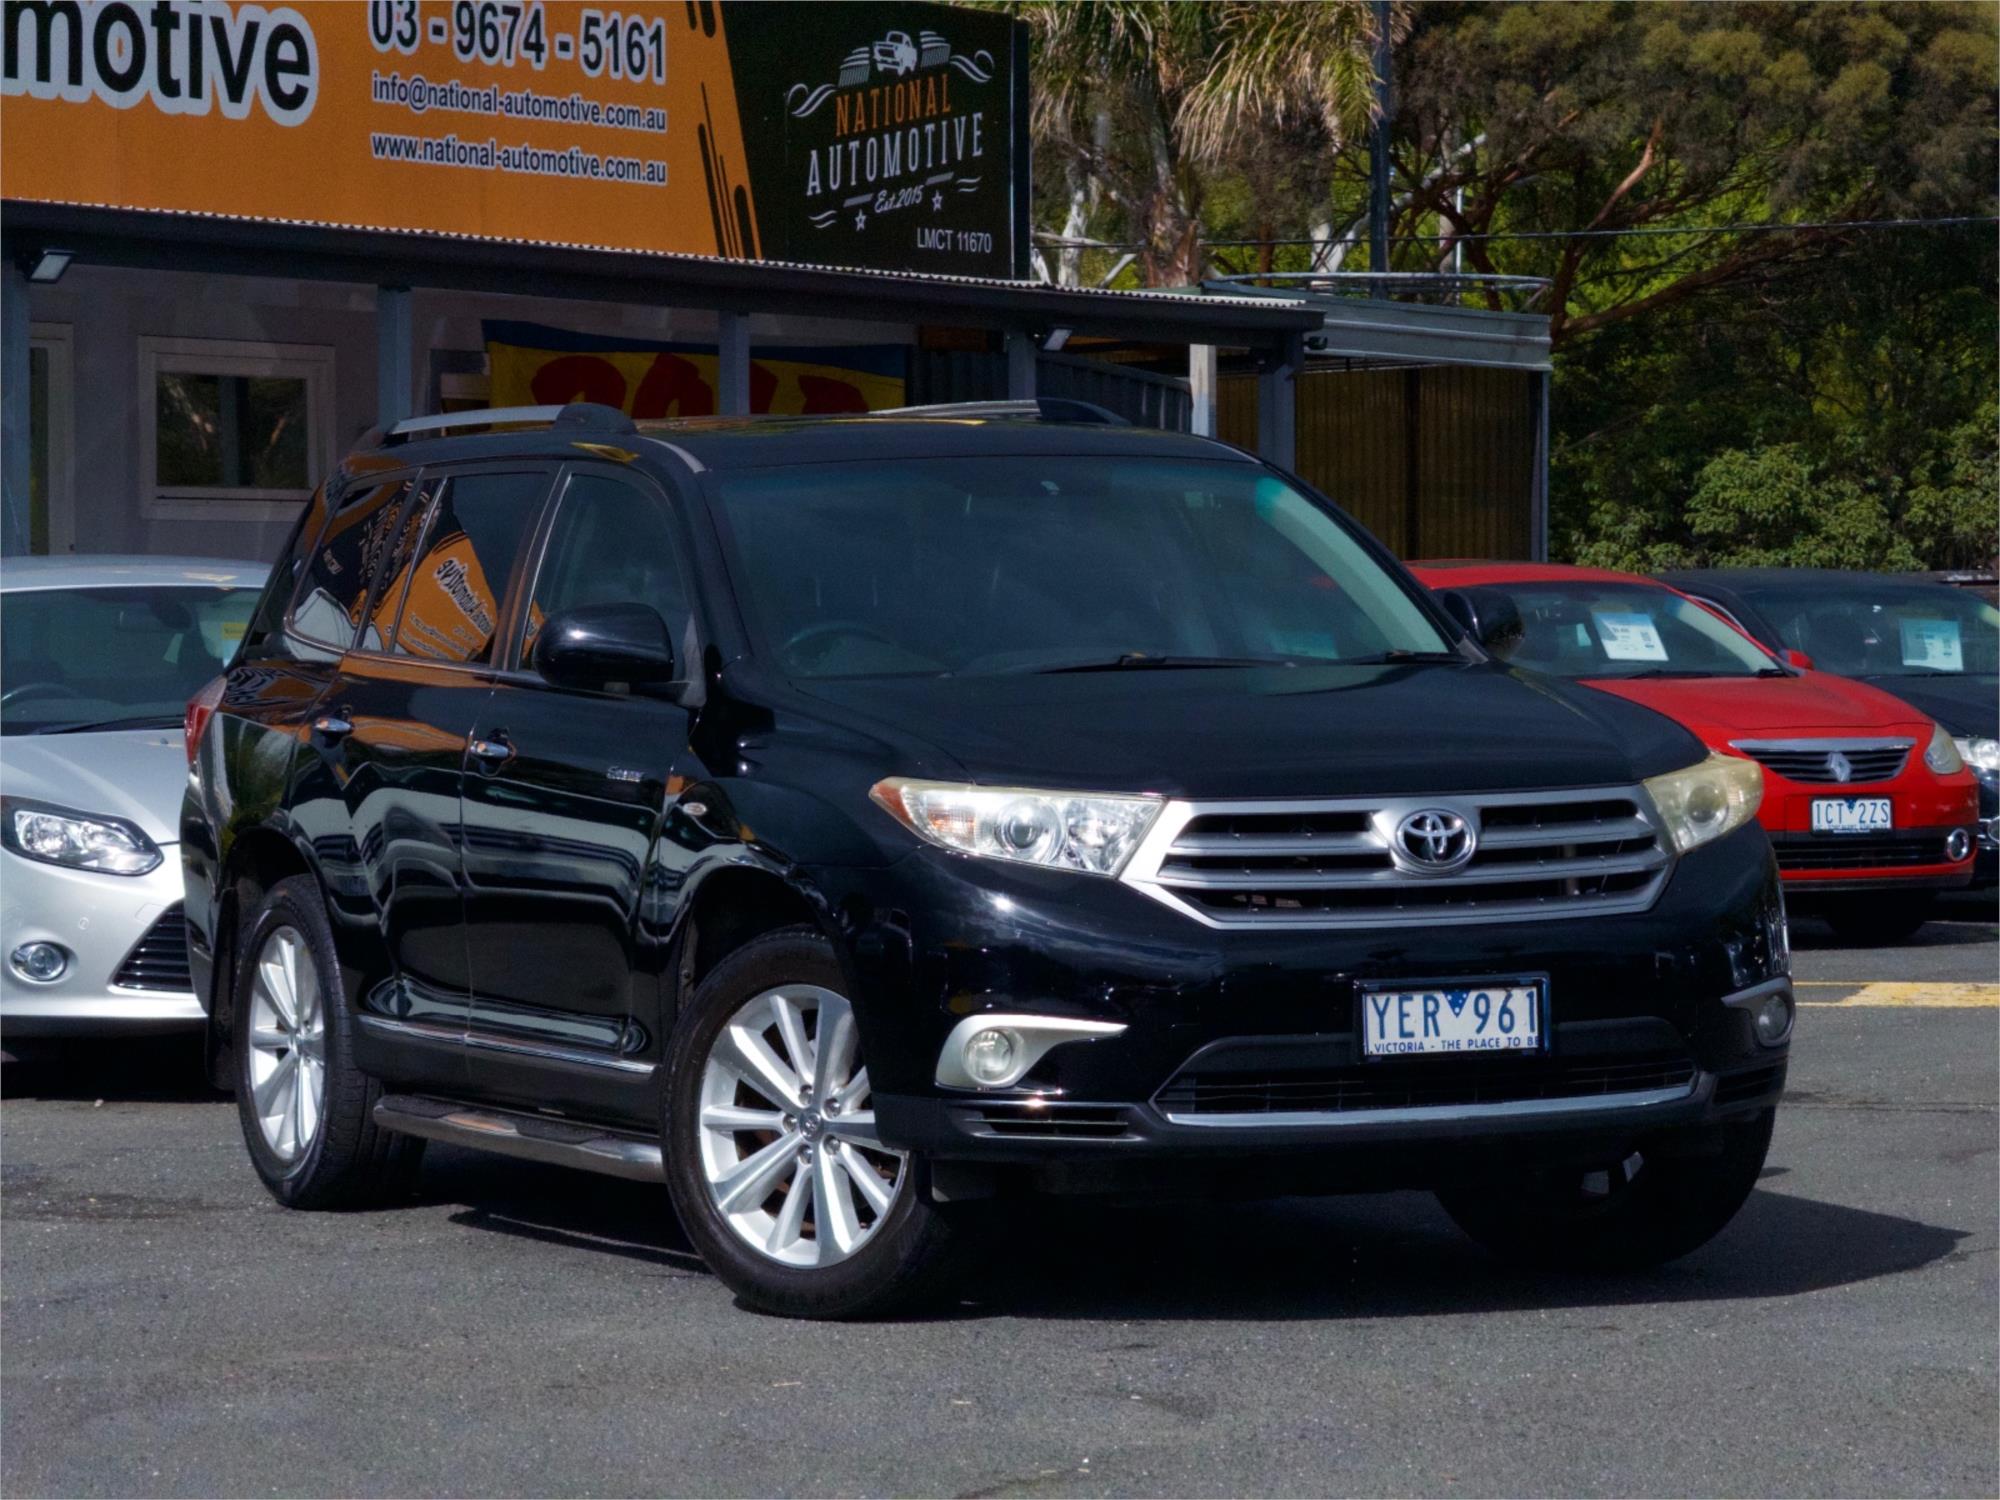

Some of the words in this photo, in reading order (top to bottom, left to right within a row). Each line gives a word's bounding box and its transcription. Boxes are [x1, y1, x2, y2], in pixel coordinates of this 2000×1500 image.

[3, 0, 311, 111] motive
[372, 0, 417, 48] 03
[456, 0, 545, 63] 9674
[582, 16, 663, 78] 5161
[373, 73, 666, 130] info@national-automotive.com.au
[835, 74, 951, 137] NATIONAL
[372, 136, 666, 183] www.national-automotive.com.au
[806, 112, 983, 196] AUTOMOTIVE
[917, 227, 953, 250] LMCT
[957, 231, 992, 253] 11670
[1371, 993, 1440, 1039] YER
[1473, 990, 1536, 1034] 961
[1375, 1041, 1425, 1053] VICTORIA
[1441, 1039, 1461, 1050] THE
[1467, 1036, 1500, 1048] PLACE
[1507, 1036, 1521, 1047] TO
